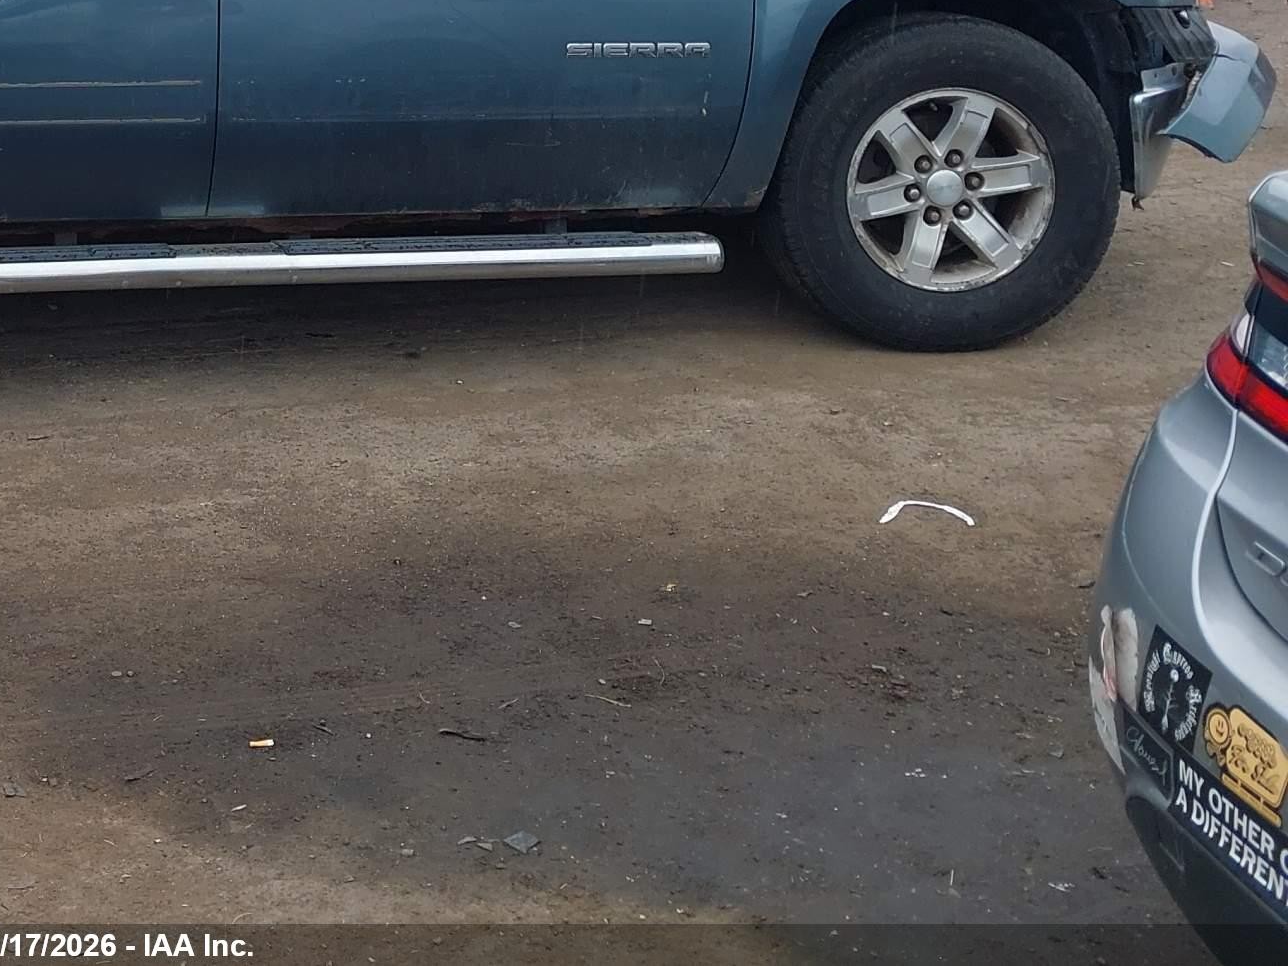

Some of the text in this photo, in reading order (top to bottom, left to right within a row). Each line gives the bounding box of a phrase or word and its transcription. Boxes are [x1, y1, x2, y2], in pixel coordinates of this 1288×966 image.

[565, 41, 712, 59] SIERRA
[1175, 786, 1188, 814] A
[1178, 758, 1205, 798] MY
[1208, 787, 1275, 862] OTHER
